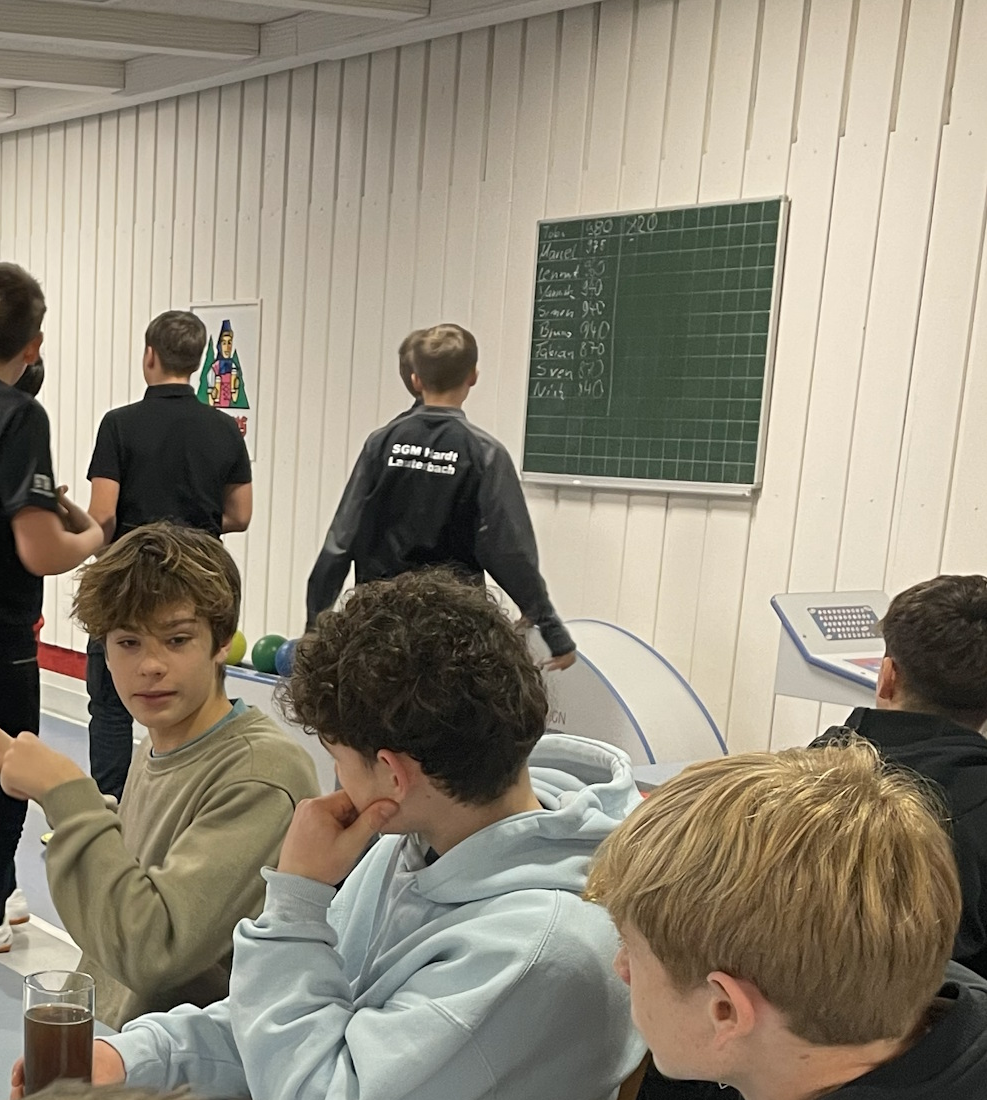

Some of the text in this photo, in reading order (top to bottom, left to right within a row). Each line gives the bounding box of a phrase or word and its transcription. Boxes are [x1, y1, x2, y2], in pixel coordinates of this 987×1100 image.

[536, 362, 573, 380] Sven
[391, 443, 459, 462] SGM Hardt
